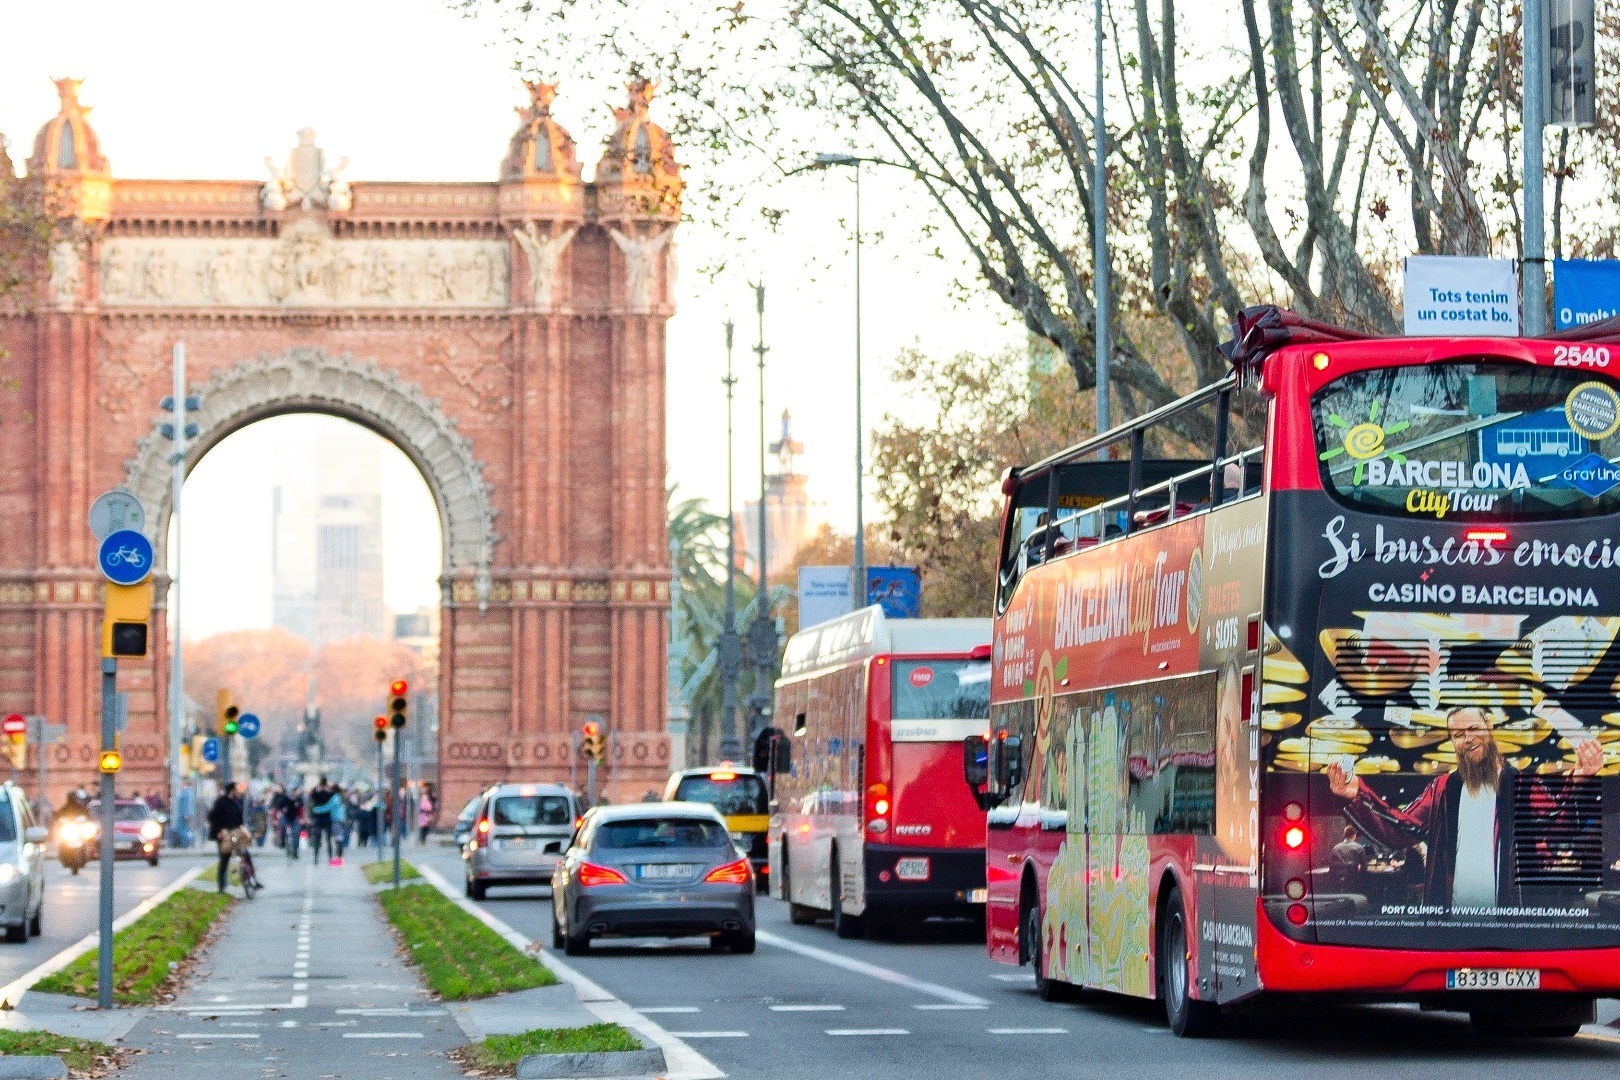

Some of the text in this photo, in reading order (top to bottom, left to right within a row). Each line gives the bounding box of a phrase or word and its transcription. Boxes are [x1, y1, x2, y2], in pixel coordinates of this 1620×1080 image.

[1429, 288, 1509, 305] Tots tenim
[1418, 307, 1512, 323] un costat bo.
[1561, 307, 1573, 324] O
[1553, 345, 1610, 367] 2540
[1581, 392, 1613, 408] OFFICIAL
[1572, 401, 1615, 421] BARCELONA
[1368, 460, 1531, 489] BARCELONA
[1318, 515, 1367, 579] Si
[1375, 524, 1506, 566] buscas
[1368, 583, 1600, 607] CASINO BARCELONA
[1054, 562, 1129, 650] BARCELONA
[1215, 616, 1239, 650] SLOTS
[895, 825, 932, 836] IVECO
[1381, 903, 1589, 917] PORT OLÍMPIC WWW.CASINOBARCELONA.COM
[1458, 971, 1536, 987] 8339 GXX
